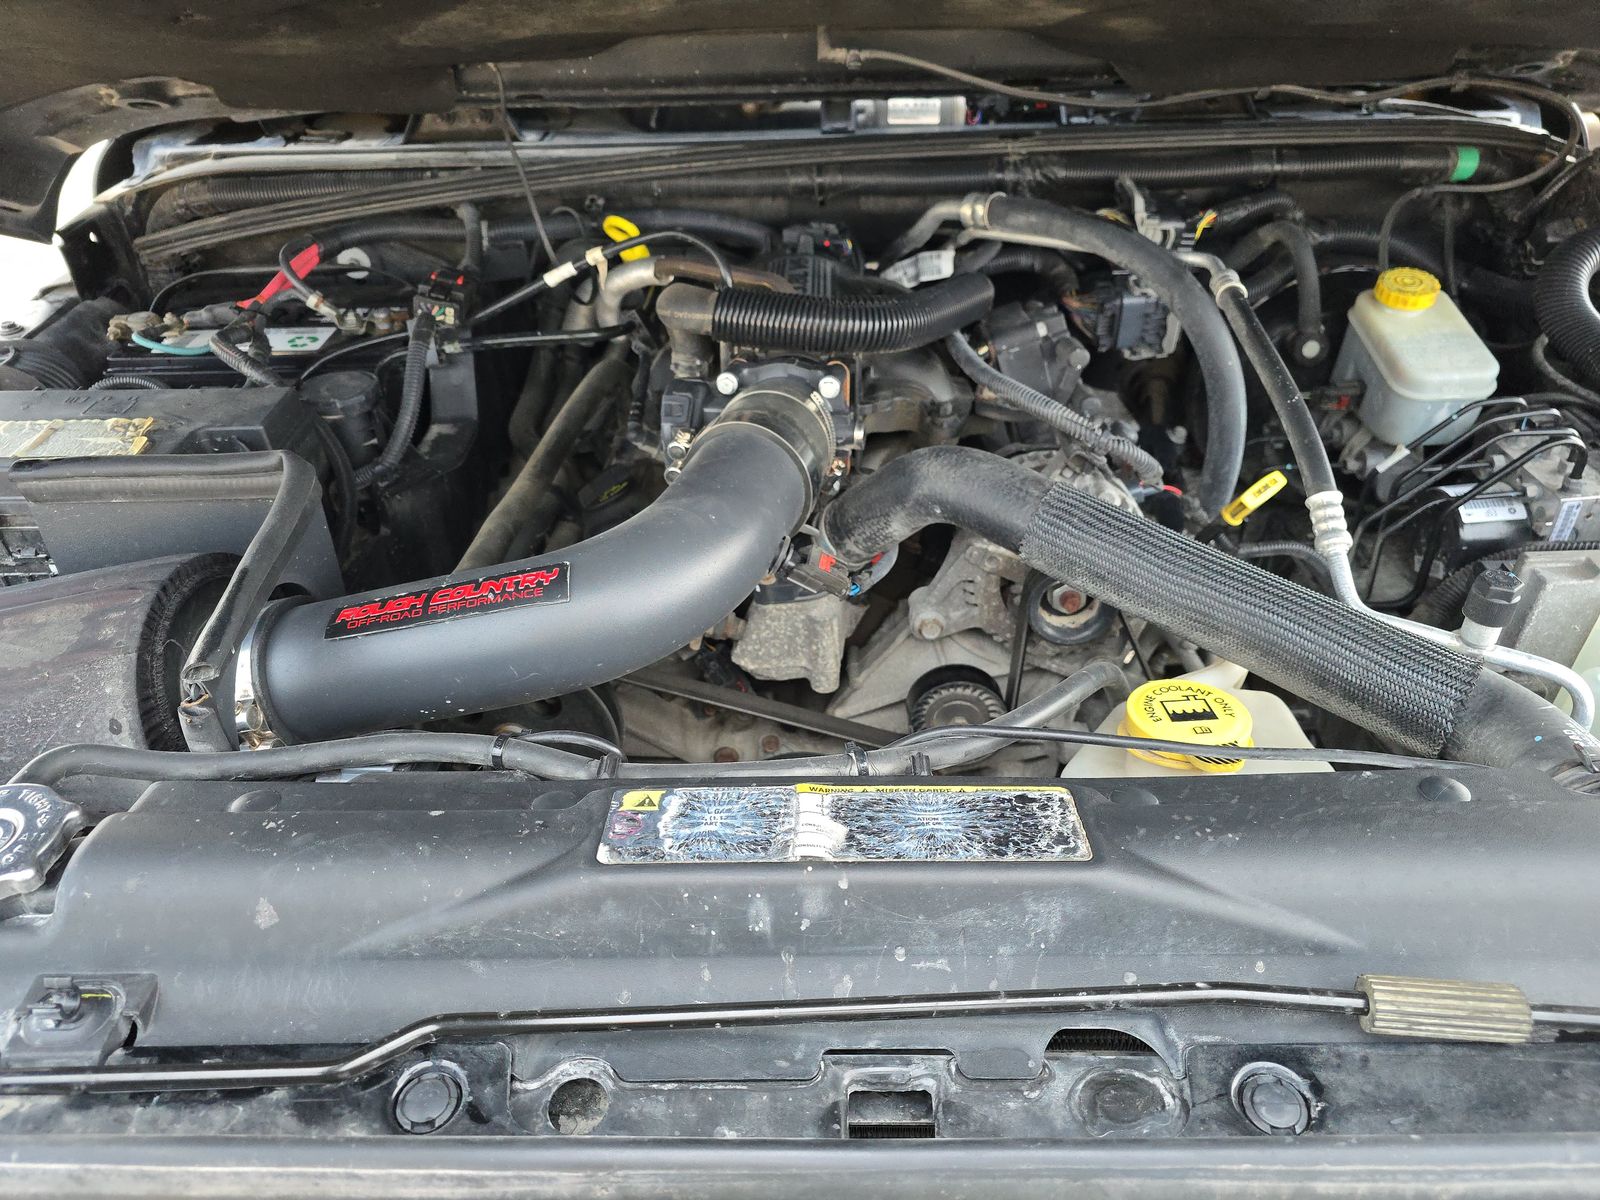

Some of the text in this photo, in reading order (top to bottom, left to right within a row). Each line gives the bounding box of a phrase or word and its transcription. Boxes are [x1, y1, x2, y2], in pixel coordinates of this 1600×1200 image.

[335, 567, 560, 623] ROUGH COUNTRY
[347, 587, 544, 629] OFF-ROAD PERFORMANCE
[1143, 685, 1236, 723] ENGINE COOLANT ONLY
